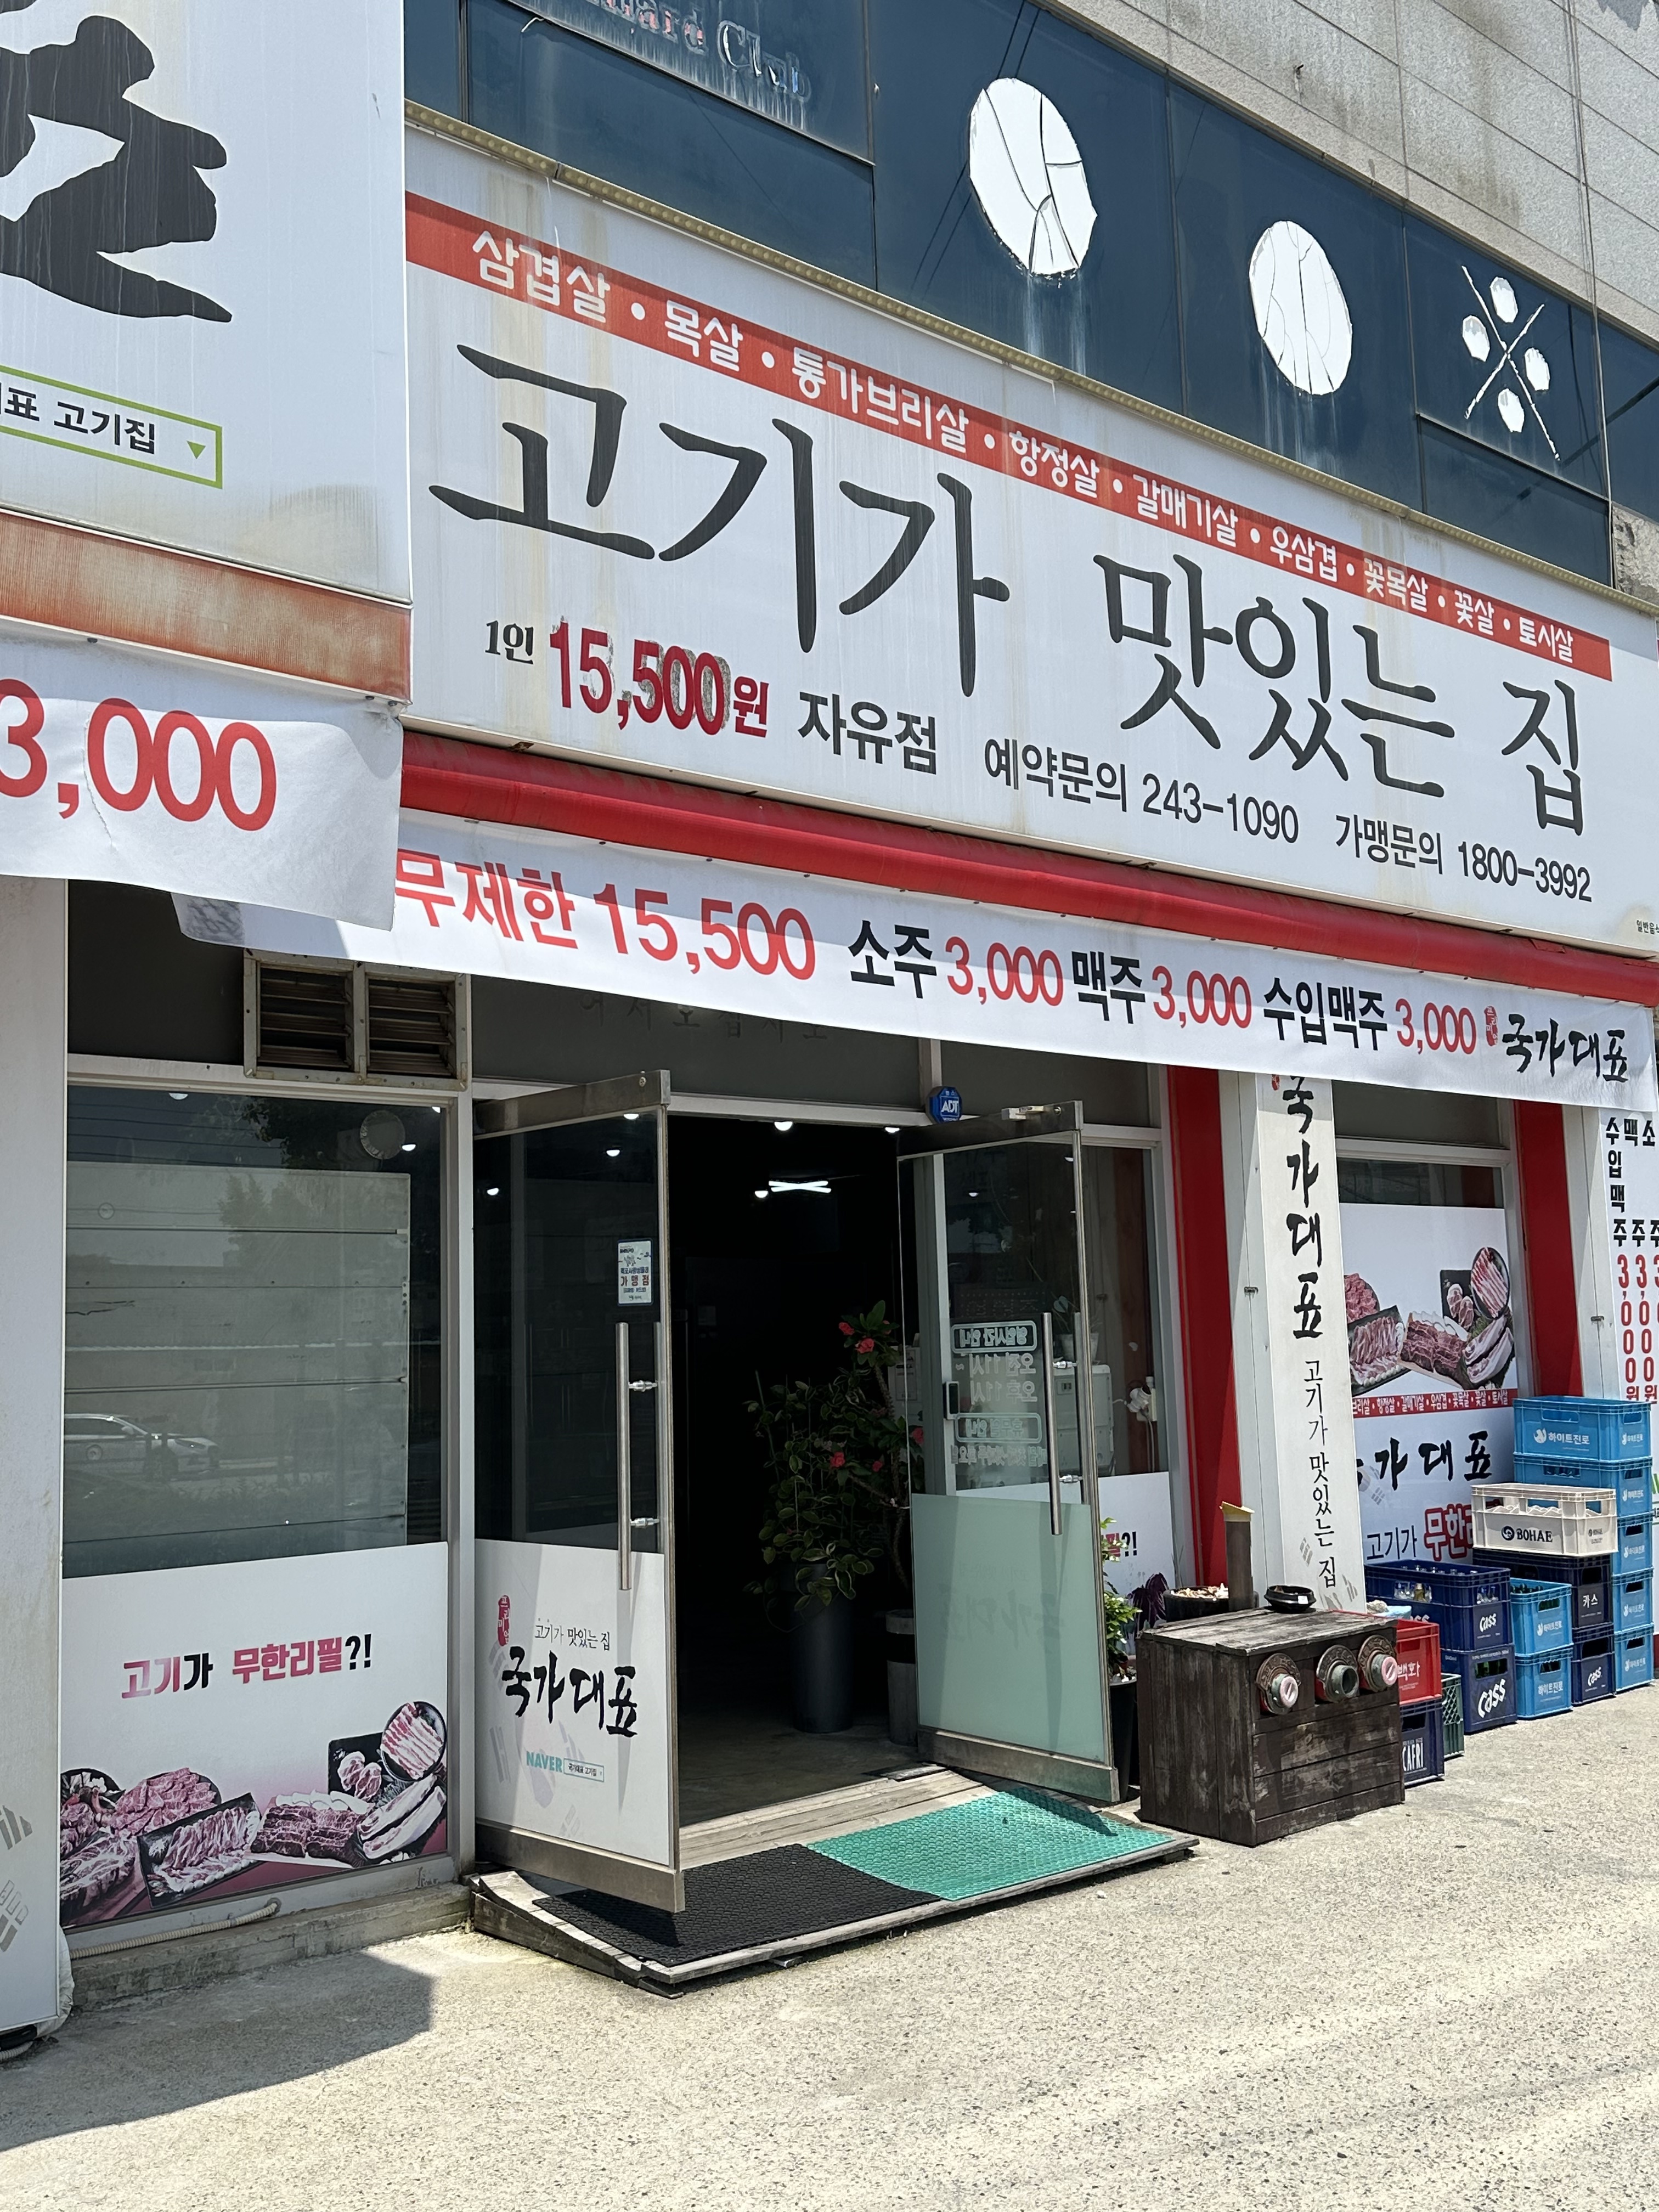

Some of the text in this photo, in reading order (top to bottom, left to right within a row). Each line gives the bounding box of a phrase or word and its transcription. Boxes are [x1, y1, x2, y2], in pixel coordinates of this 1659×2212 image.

[718, 20, 811, 103] Club
[0, 381, 156, 455] 표 고기집
[472, 230, 1574, 664] 삼겹살 목살 통가브리살 항정살 갈매기살 우삼겹 꽃목살 꽃살 토시살
[428, 344, 1584, 837] 고기가 맛있는 집
[0, 678, 277, 832] 3,000
[484, 616, 1594, 903] 1인 15,500원 자유점 예약문의 243-1090 가맹문의 1800-3992
[395, 848, 1477, 1055] 무제한 15,500 소주 3,000 맥주 3,000 수입맥주 3,000
[1502, 1012, 1629, 1083] 국가대표
[941, 1099, 959, 1113] ADT
[1605, 1116, 1628, 1248] 수입맥주
[1623, 1118, 1646, 1248] 맥주
[1282, 1075, 1336, 1589] 국가대표 고기가 맛있는 집
[1548, 1432, 1590, 1445] 하이트진로
[1367, 1525, 1418, 1561] 고기가
[1516, 1528, 1553, 1543] BOHAE
[1479, 1613, 1497, 1633] Cass
[1582, 1594, 1598, 1609] 카스
[121, 1633, 372, 1699] 고기가 무한리필?!
[534, 1624, 610, 1651] 고기가 맛있는 집
[501, 1646, 638, 1738] 국가대표
[1477, 1678, 1506, 1718] Cass
[1538, 1681, 1564, 1696] 하이트진로
[526, 1751, 563, 1773] NAVER
[1402, 1742, 1424, 1771] CAFRI
